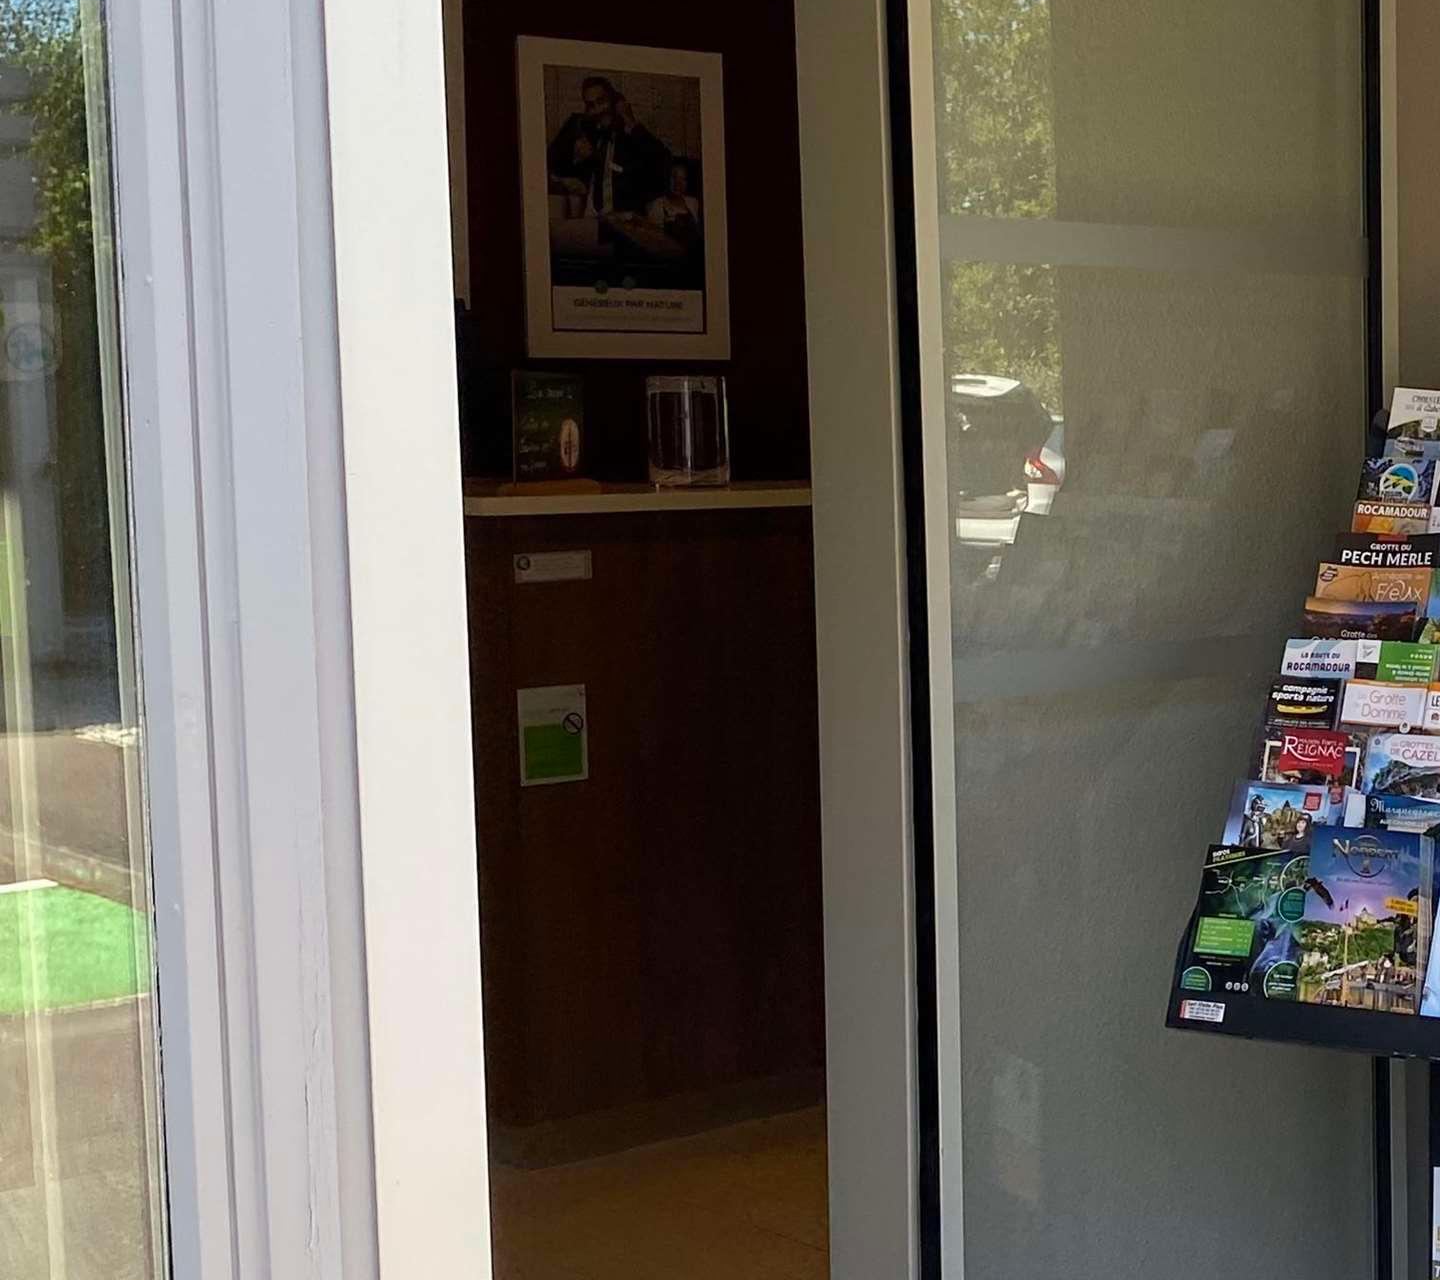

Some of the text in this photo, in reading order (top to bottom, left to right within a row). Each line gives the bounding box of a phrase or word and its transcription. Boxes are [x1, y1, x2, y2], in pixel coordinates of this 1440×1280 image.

[1357, 503, 1428, 519] ROCAMADOUR
[1370, 543, 1412, 552] GROTTE DU
[1341, 550, 1433, 567] PECH MERLE
[1340, 628, 1366, 639] Grotte
[1286, 660, 1351, 672] ROCAMADOUR
[1368, 689, 1407, 705] Grotte
[1361, 703, 1407, 719] Domme
[1282, 735, 1344, 761] REIGNAC
